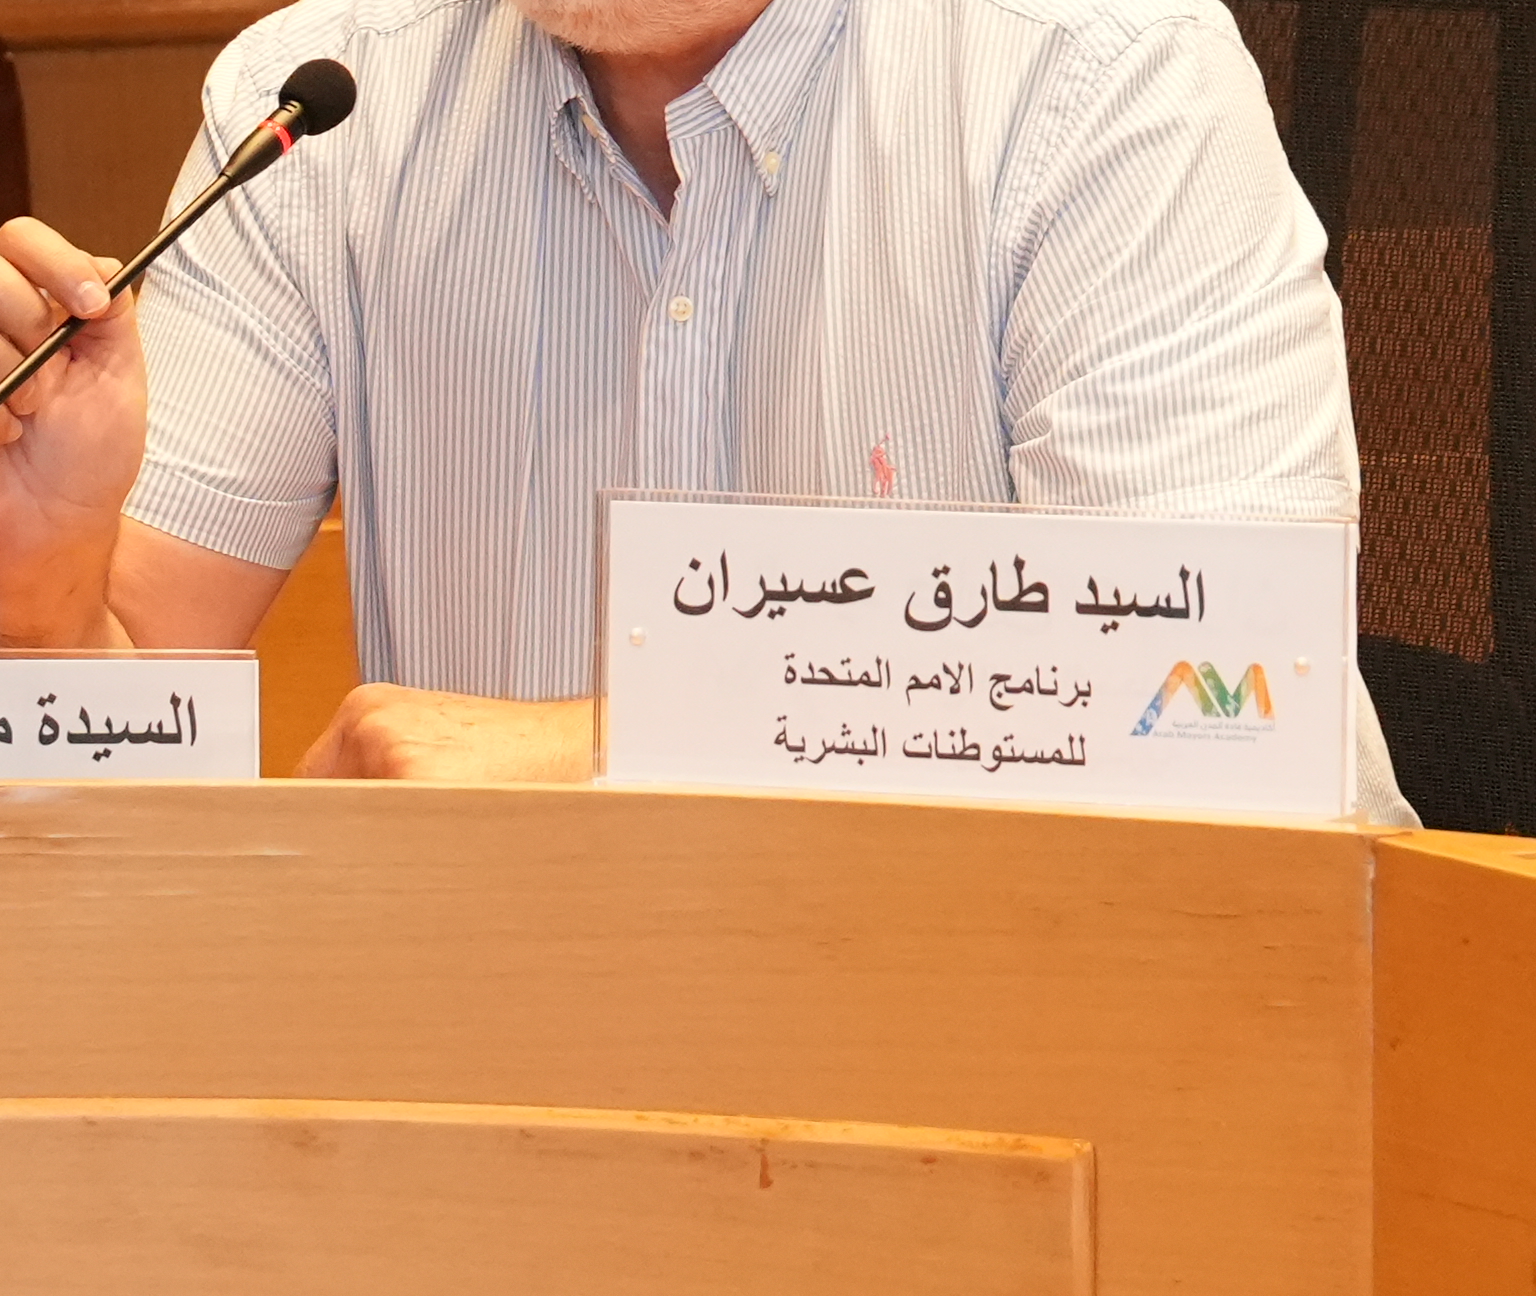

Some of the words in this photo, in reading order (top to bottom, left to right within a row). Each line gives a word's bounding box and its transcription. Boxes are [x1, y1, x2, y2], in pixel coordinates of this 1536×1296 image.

[673, 550, 876, 620] عسيران
[904, 554, 1050, 632] طارق
[1075, 564, 1205, 635] السيد
[784, 652, 891, 689] المتحدة
[905, 661, 974, 706] الامم
[989, 665, 1092, 712] برنامج
[36, 691, 197, 763] السيدة
[773, 715, 887, 766] البشرية
[902, 727, 1086, 773] للمستوطنات
